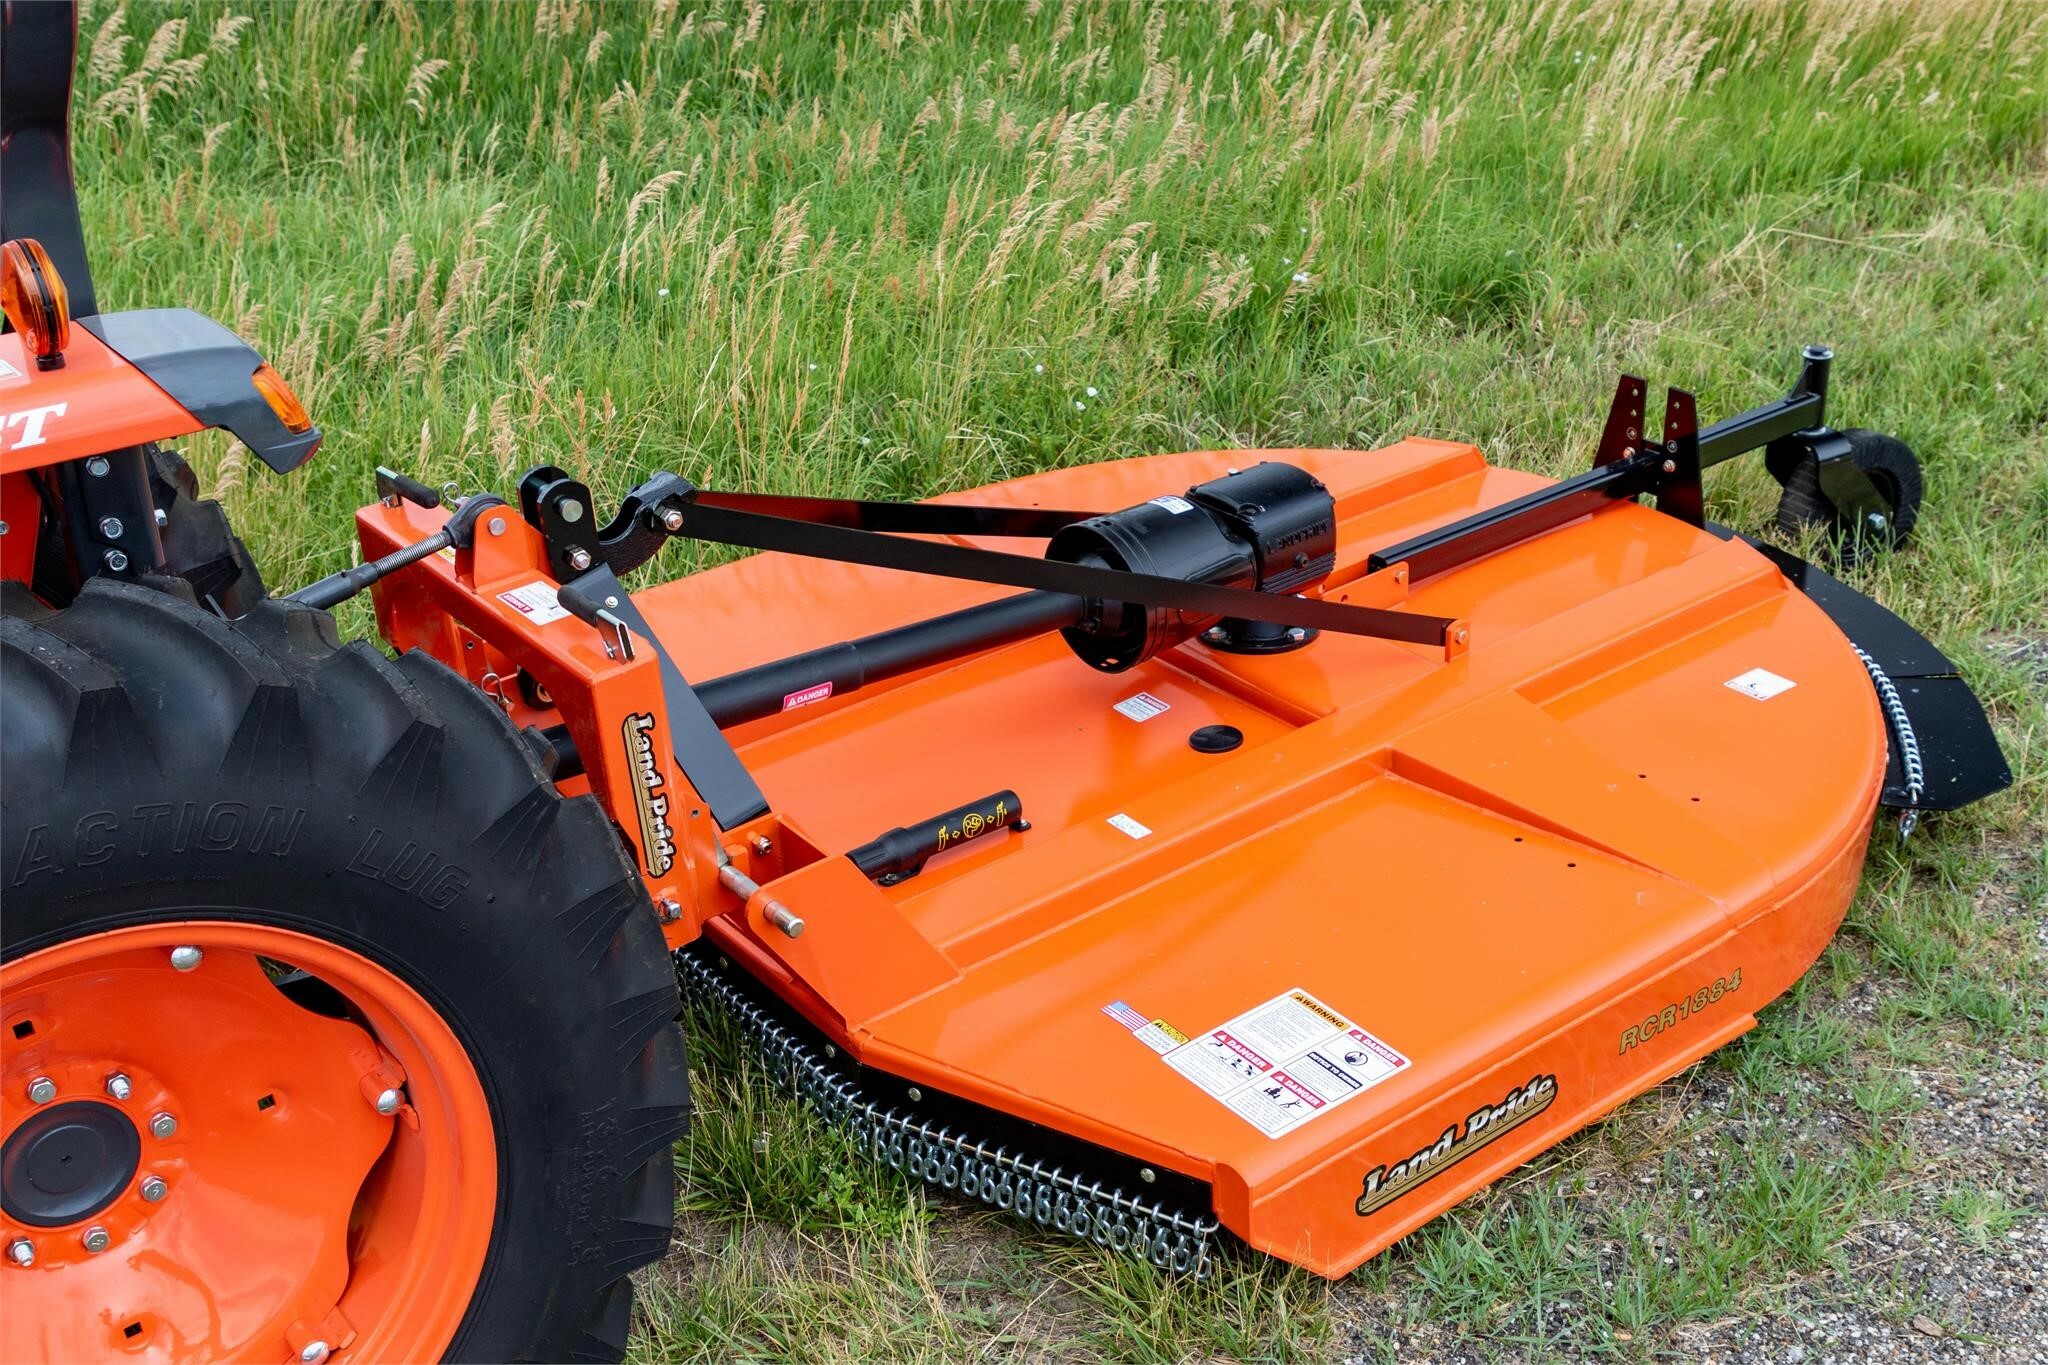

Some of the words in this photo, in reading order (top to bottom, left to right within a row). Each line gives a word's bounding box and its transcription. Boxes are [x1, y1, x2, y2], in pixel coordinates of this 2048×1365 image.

[0, 401, 69, 450] T
[797, 687, 829, 704] DANGER
[631, 712, 664, 788] Land
[645, 793, 677, 872] Pride
[12, 799, 306, 888] ACTION
[345, 827, 472, 910] LUG
[1302, 998, 1345, 1028] WARNING
[1618, 968, 1742, 1055] RCR1884
[1225, 1039, 1266, 1068] DANGER
[1308, 1053, 1331, 1069] NOTICE
[1329, 1065, 1341, 1075] TO
[1337, 1072, 1361, 1089] OWNER
[1361, 1038, 1400, 1063] DANGER
[1283, 1079, 1321, 1106] DANGER
[1362, 1124, 1458, 1204] Land
[1464, 1074, 1558, 1146] Pride
